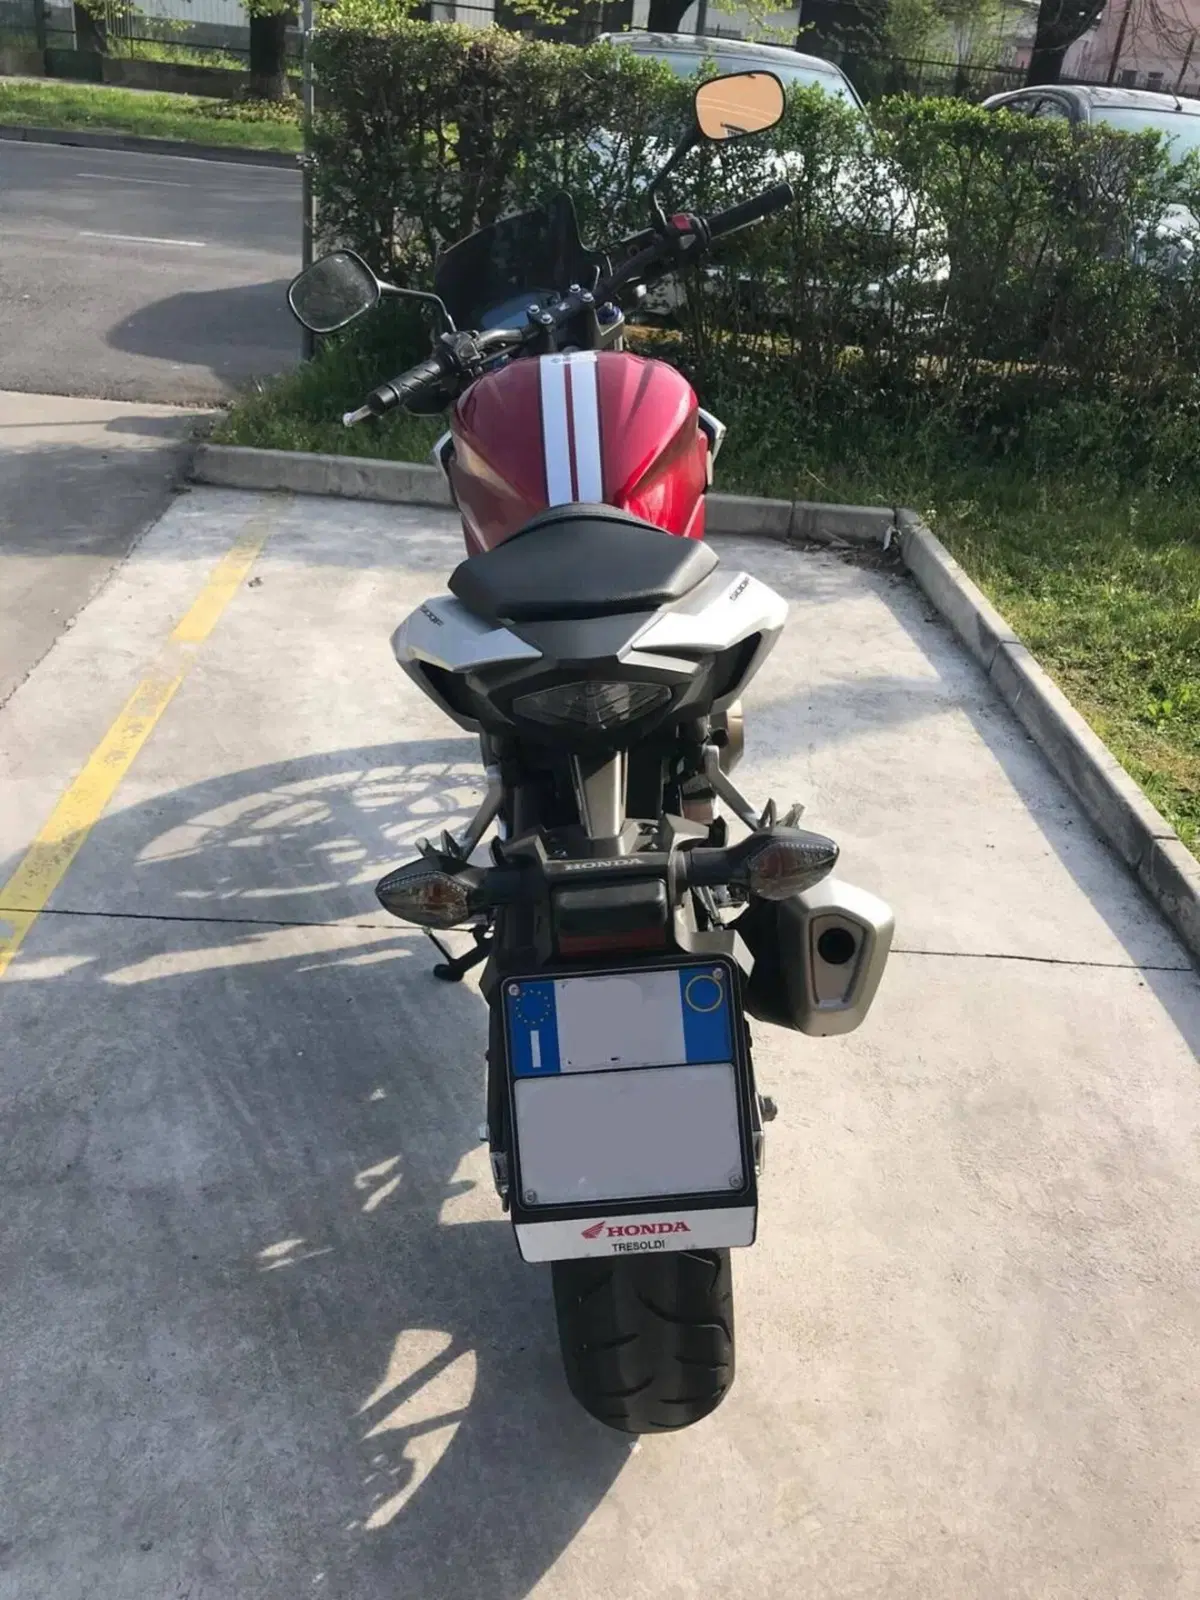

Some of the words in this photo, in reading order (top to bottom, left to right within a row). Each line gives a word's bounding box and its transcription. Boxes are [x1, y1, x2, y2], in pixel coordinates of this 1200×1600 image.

[564, 858, 643, 871] HONDA
[606, 1221, 691, 1237] HONDA
[612, 1240, 665, 1252] TRESOLDI
